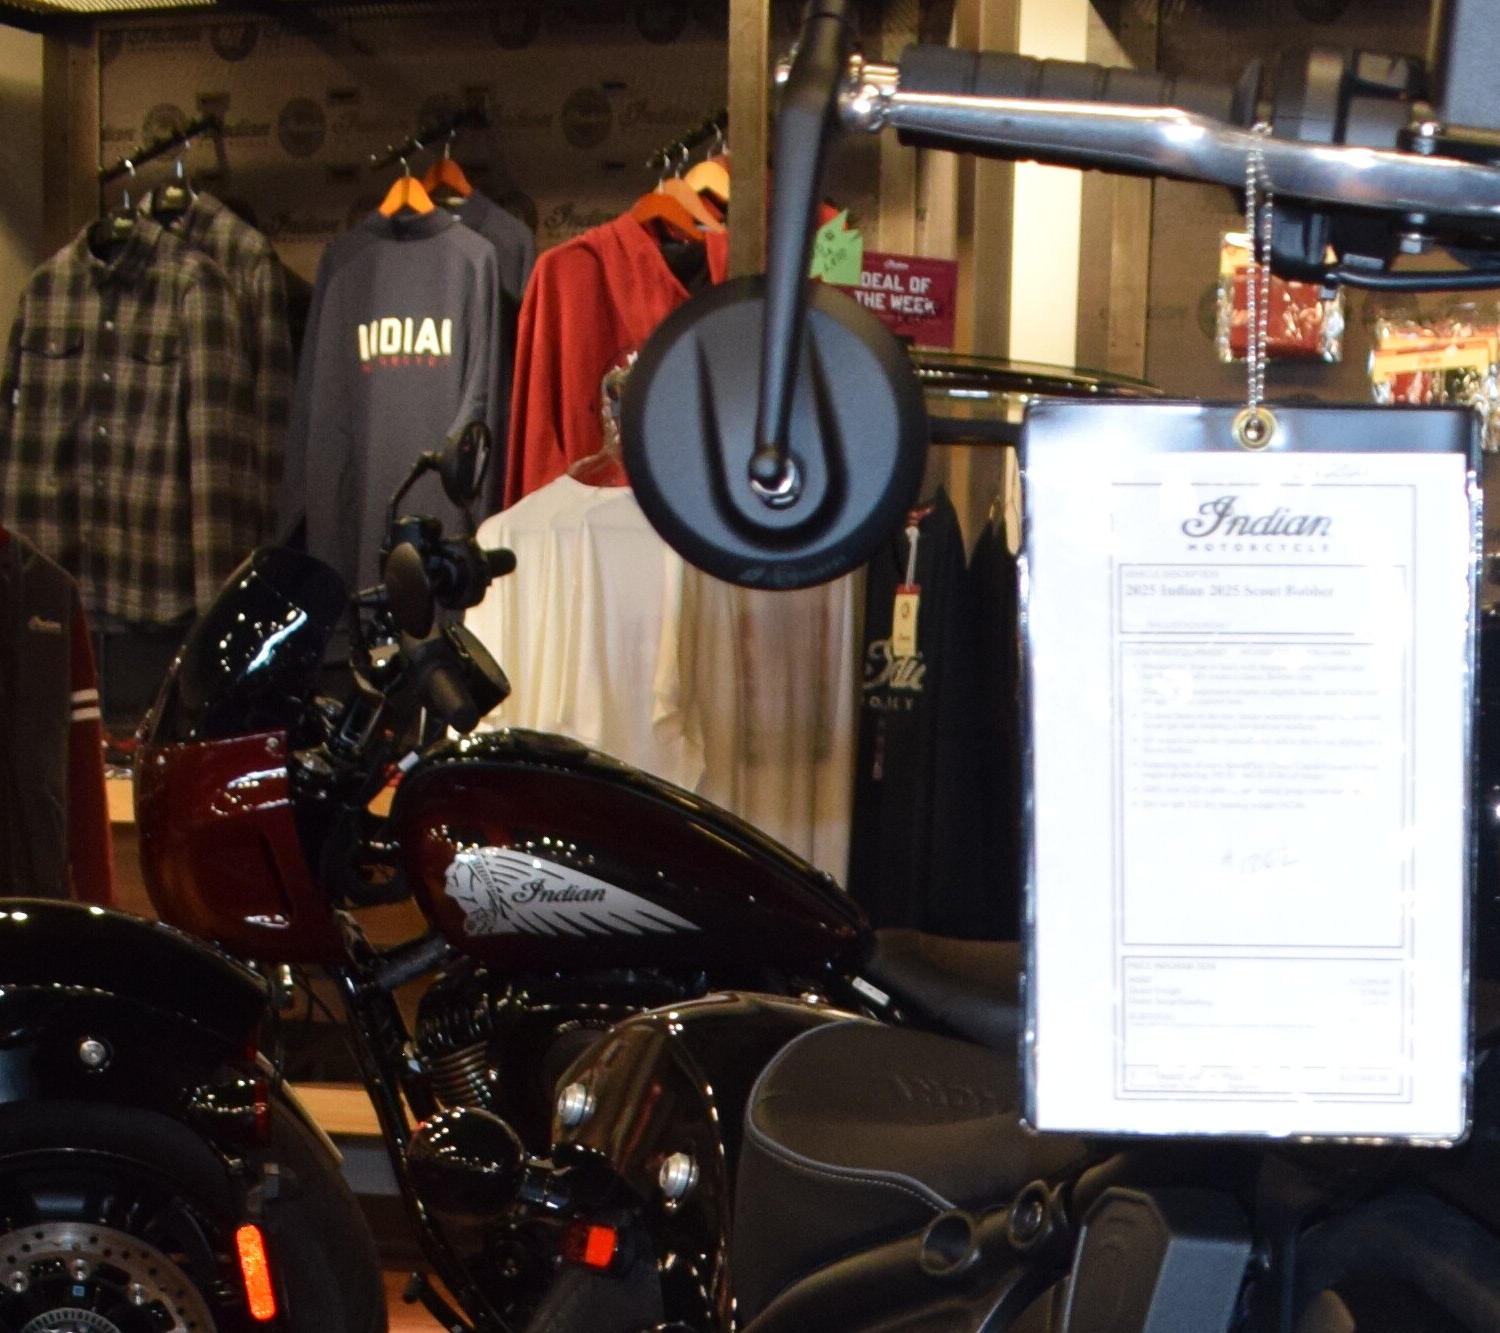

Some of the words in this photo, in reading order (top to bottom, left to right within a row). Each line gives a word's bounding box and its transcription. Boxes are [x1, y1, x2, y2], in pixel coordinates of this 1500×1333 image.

[861, 271, 905, 292] DEAL
[909, 276, 932, 294] OF
[855, 290, 886, 310] THE
[890, 293, 936, 316] WEEK
[1181, 495, 1333, 538] Indian
[1187, 542, 1330, 553] MOTORCYCLE
[510, 878, 607, 906] Indian
